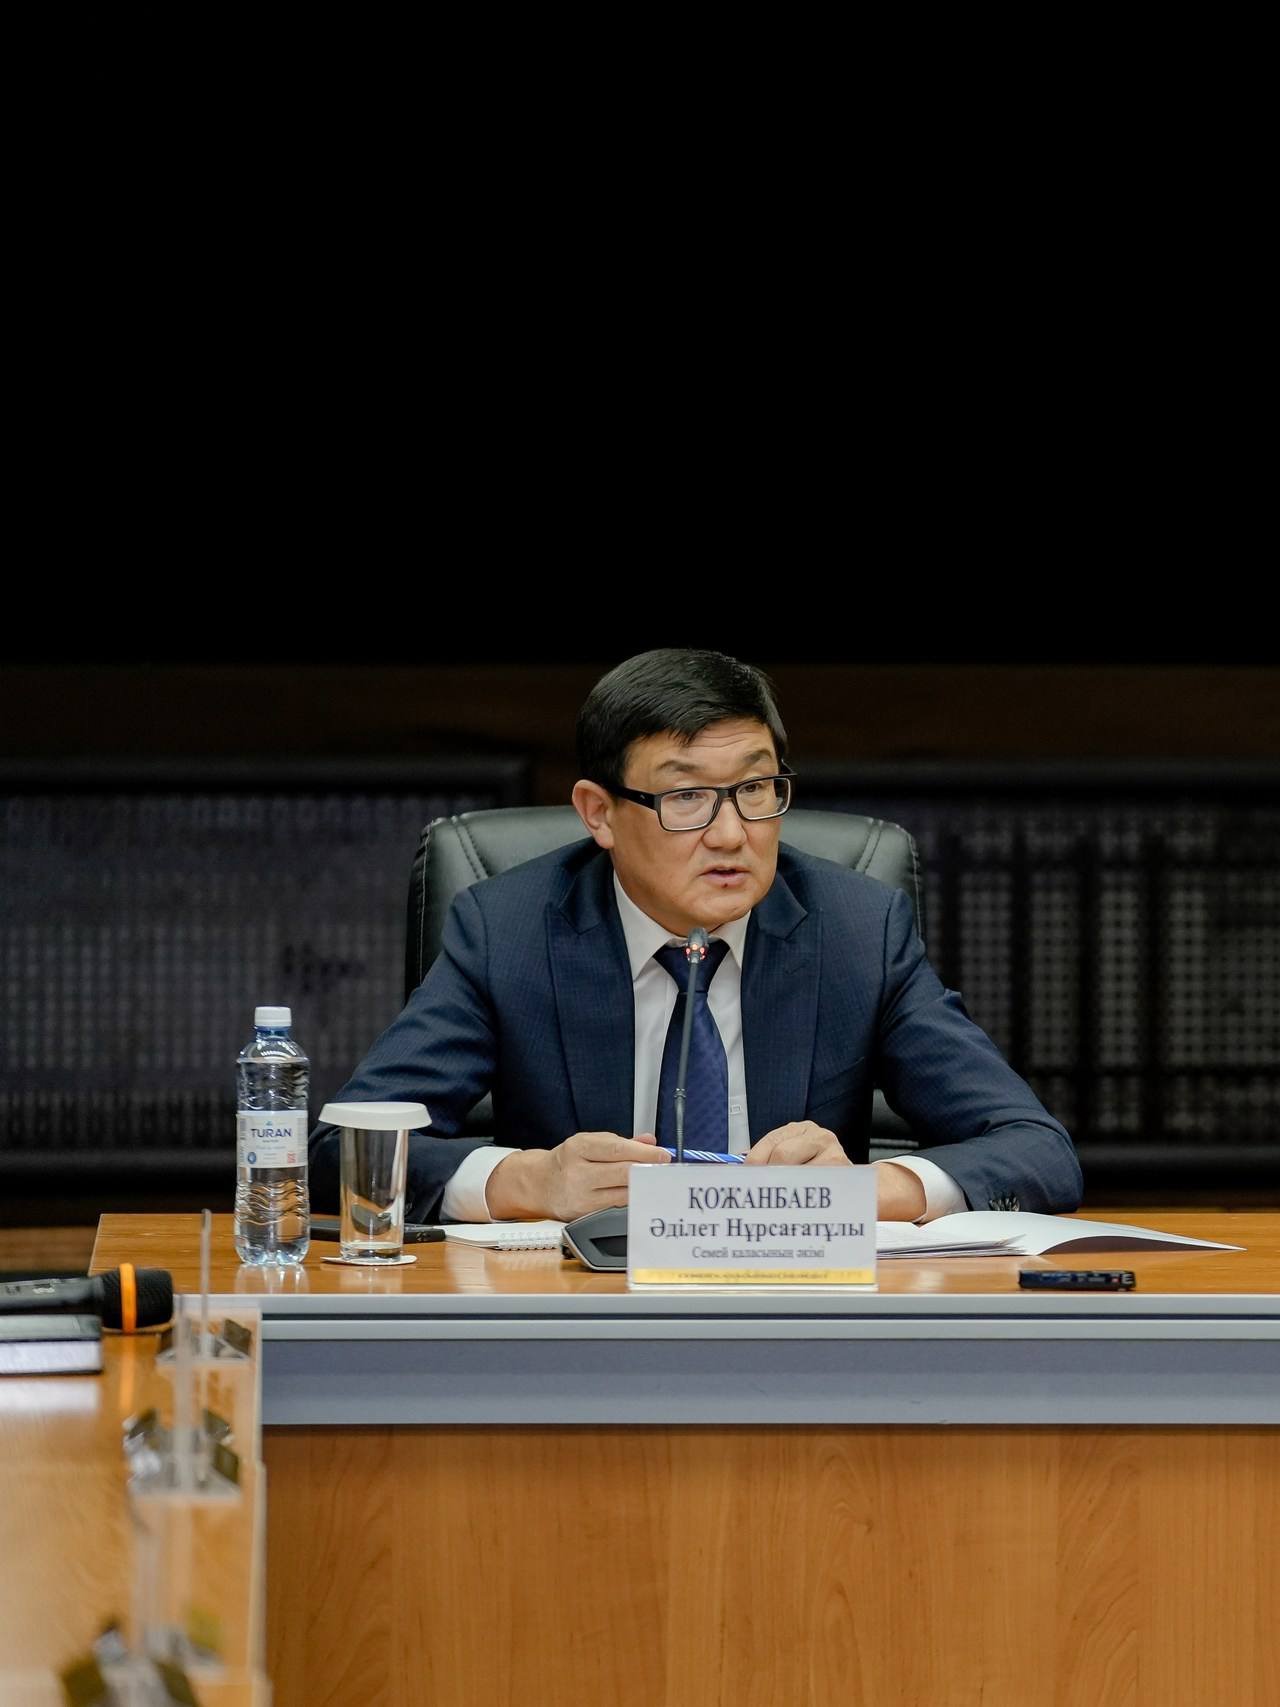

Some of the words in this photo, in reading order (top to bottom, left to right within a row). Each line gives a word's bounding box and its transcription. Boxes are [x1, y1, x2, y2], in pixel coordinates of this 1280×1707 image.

[250, 1128, 292, 1138] TURAN
[688, 1186, 832, 1213] ҚОЖАНБАЕВ
[650, 1217, 720, 1239] Әділет
[725, 1217, 865, 1242] Нұрсағатұлы
